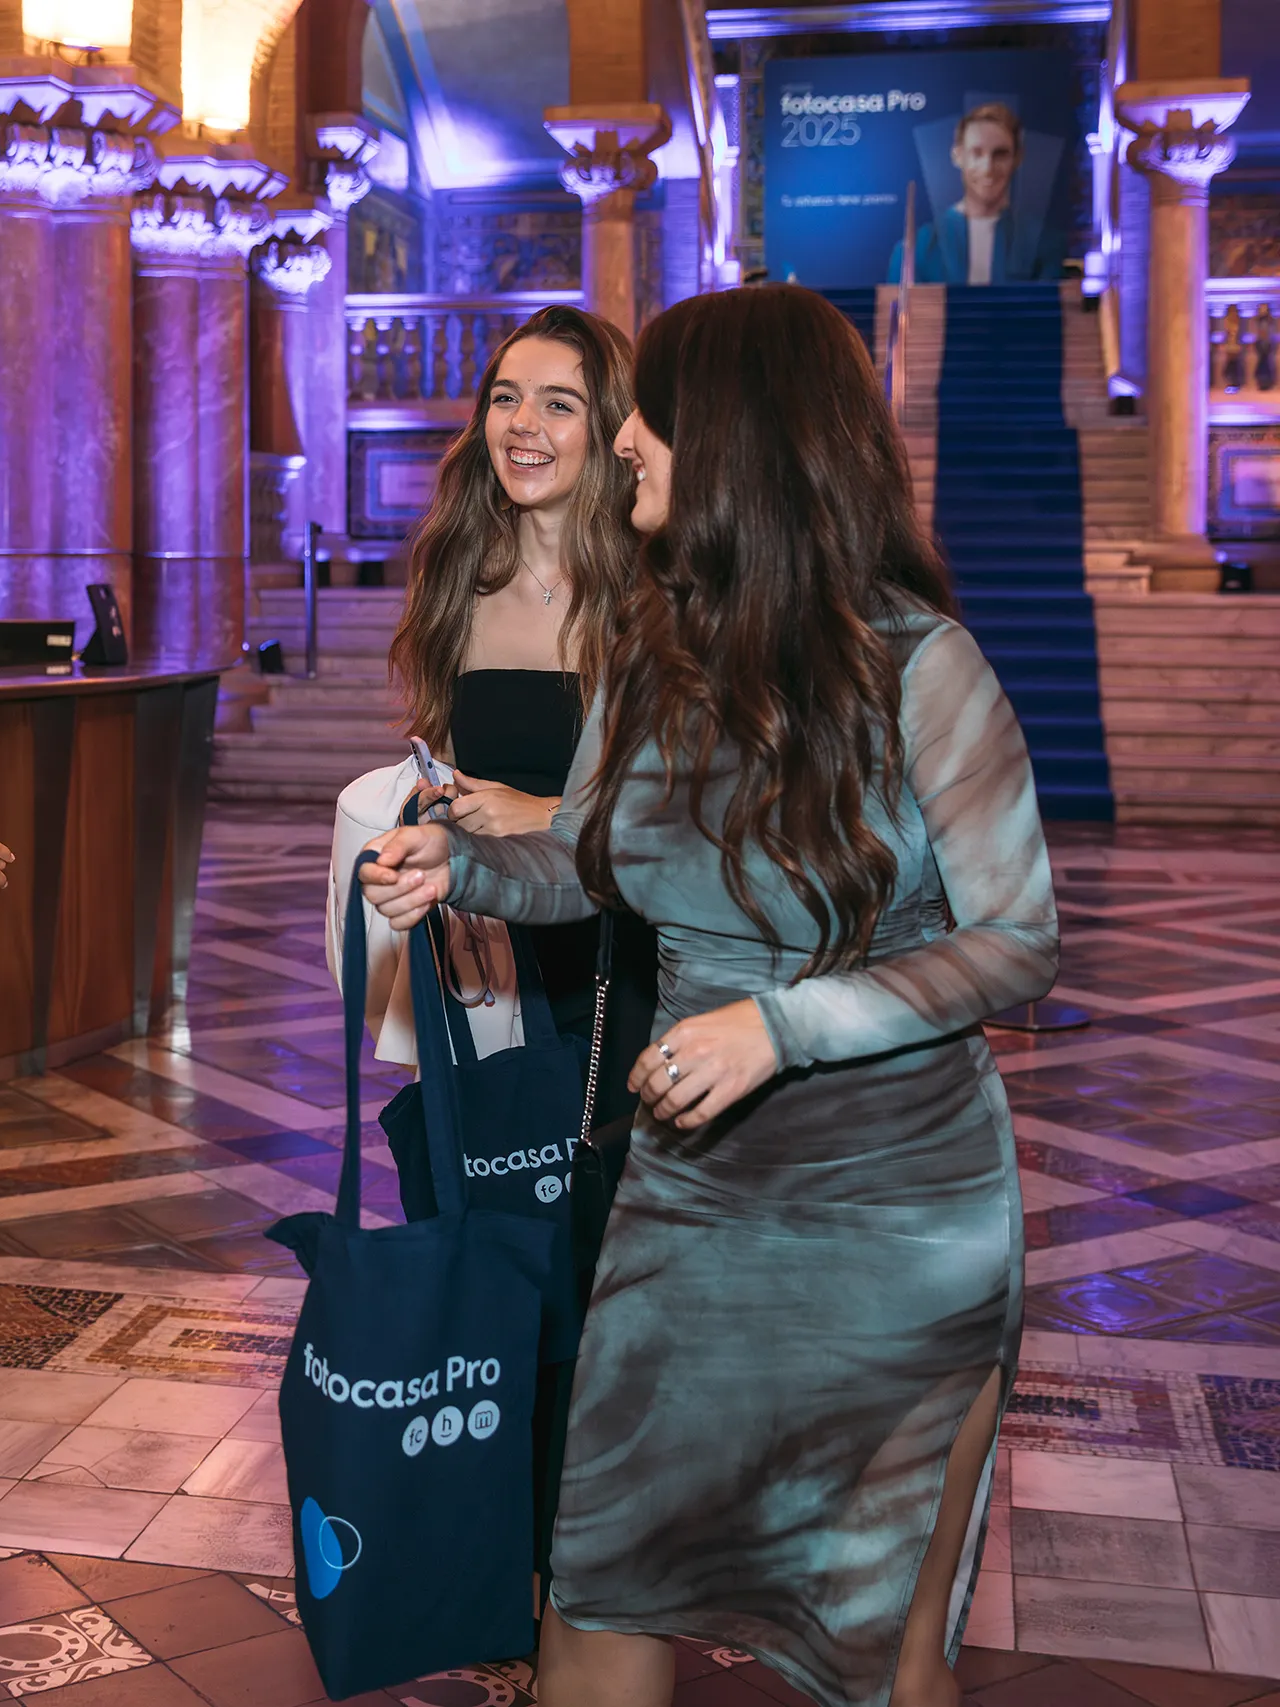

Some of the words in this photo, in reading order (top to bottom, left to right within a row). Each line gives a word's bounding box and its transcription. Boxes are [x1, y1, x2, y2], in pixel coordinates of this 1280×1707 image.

[781, 92, 884, 115] fotocasa
[887, 89, 926, 111] Pro
[781, 115, 861, 147] 2025
[463, 1143, 563, 1177] tocasa
[304, 1342, 439, 1409] fotocasa
[446, 1355, 501, 1392] Pro
